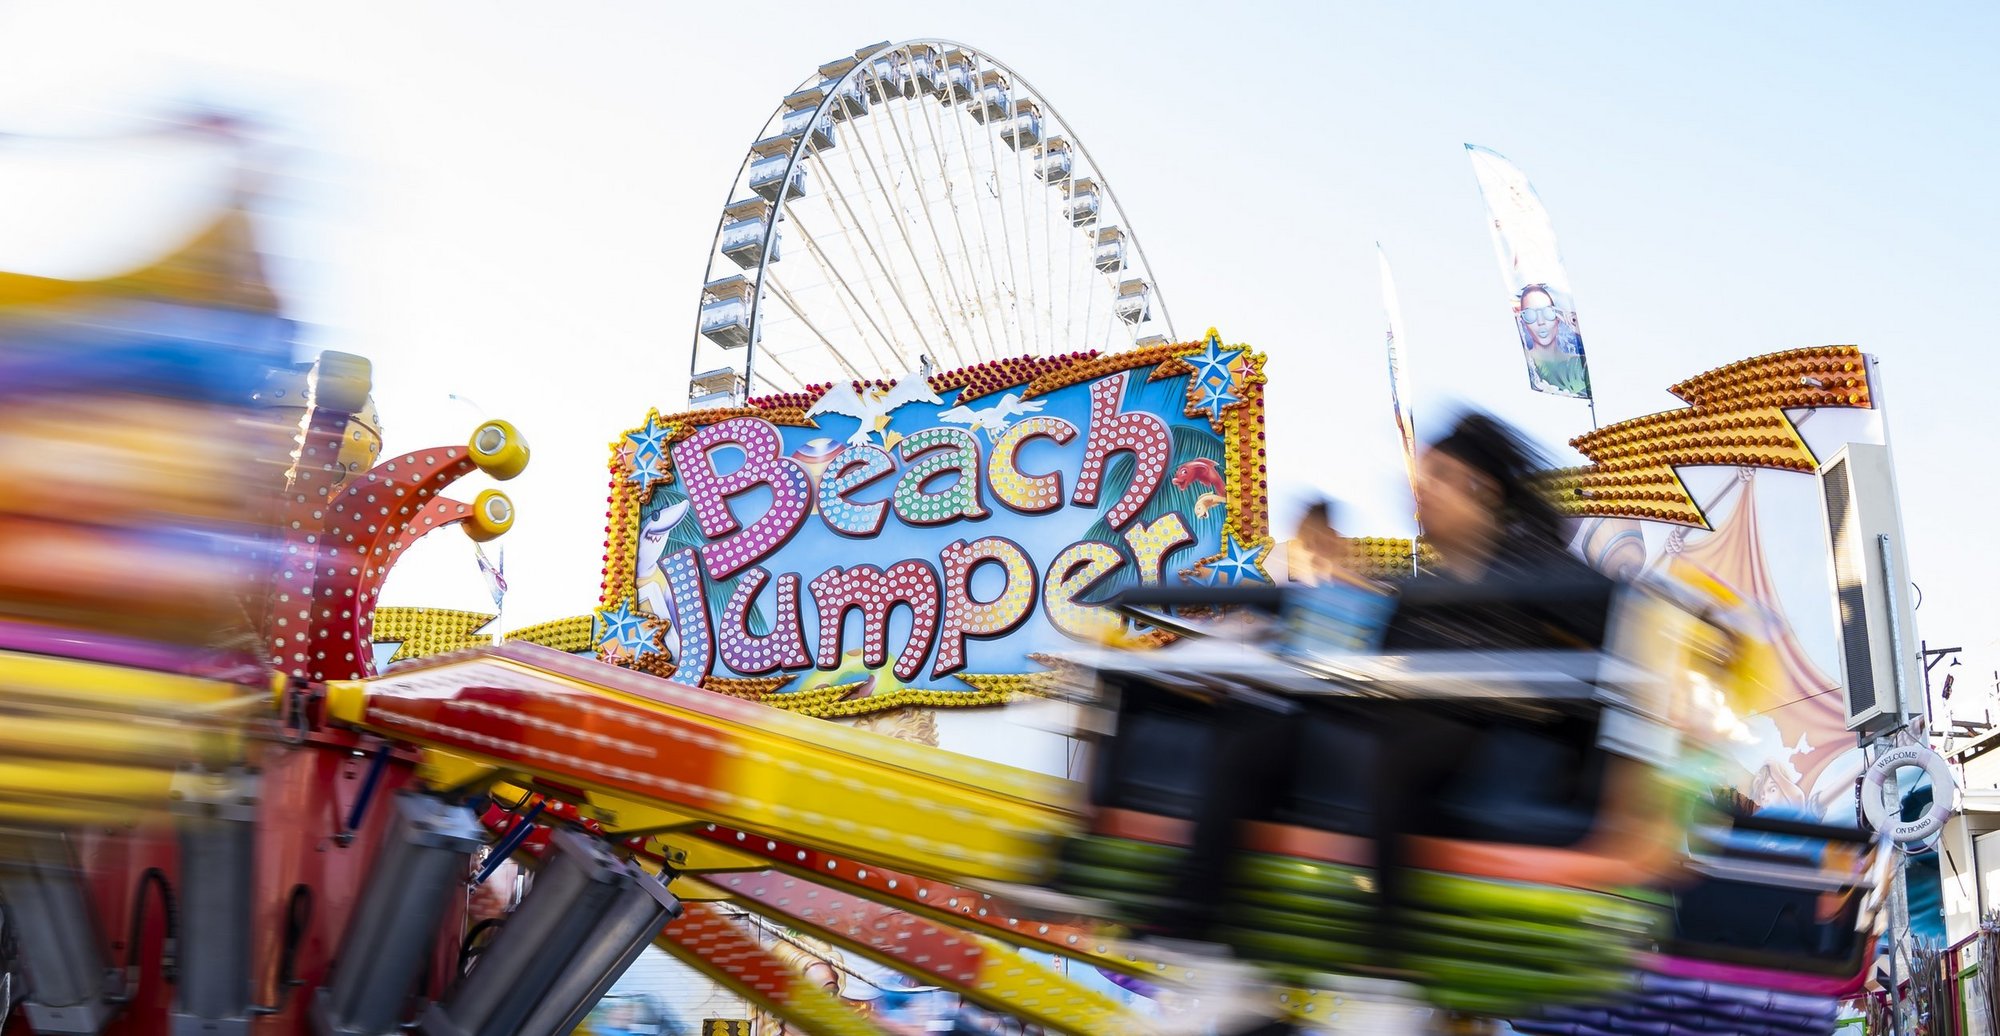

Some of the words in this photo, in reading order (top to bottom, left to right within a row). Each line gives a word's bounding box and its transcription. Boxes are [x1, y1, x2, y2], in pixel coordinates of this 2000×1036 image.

[671, 371, 1174, 580] Beach
[660, 512, 1197, 688] Jumper
[1877, 751, 1917, 768] WELCOME
[1908, 818, 1931, 834] BOARD
